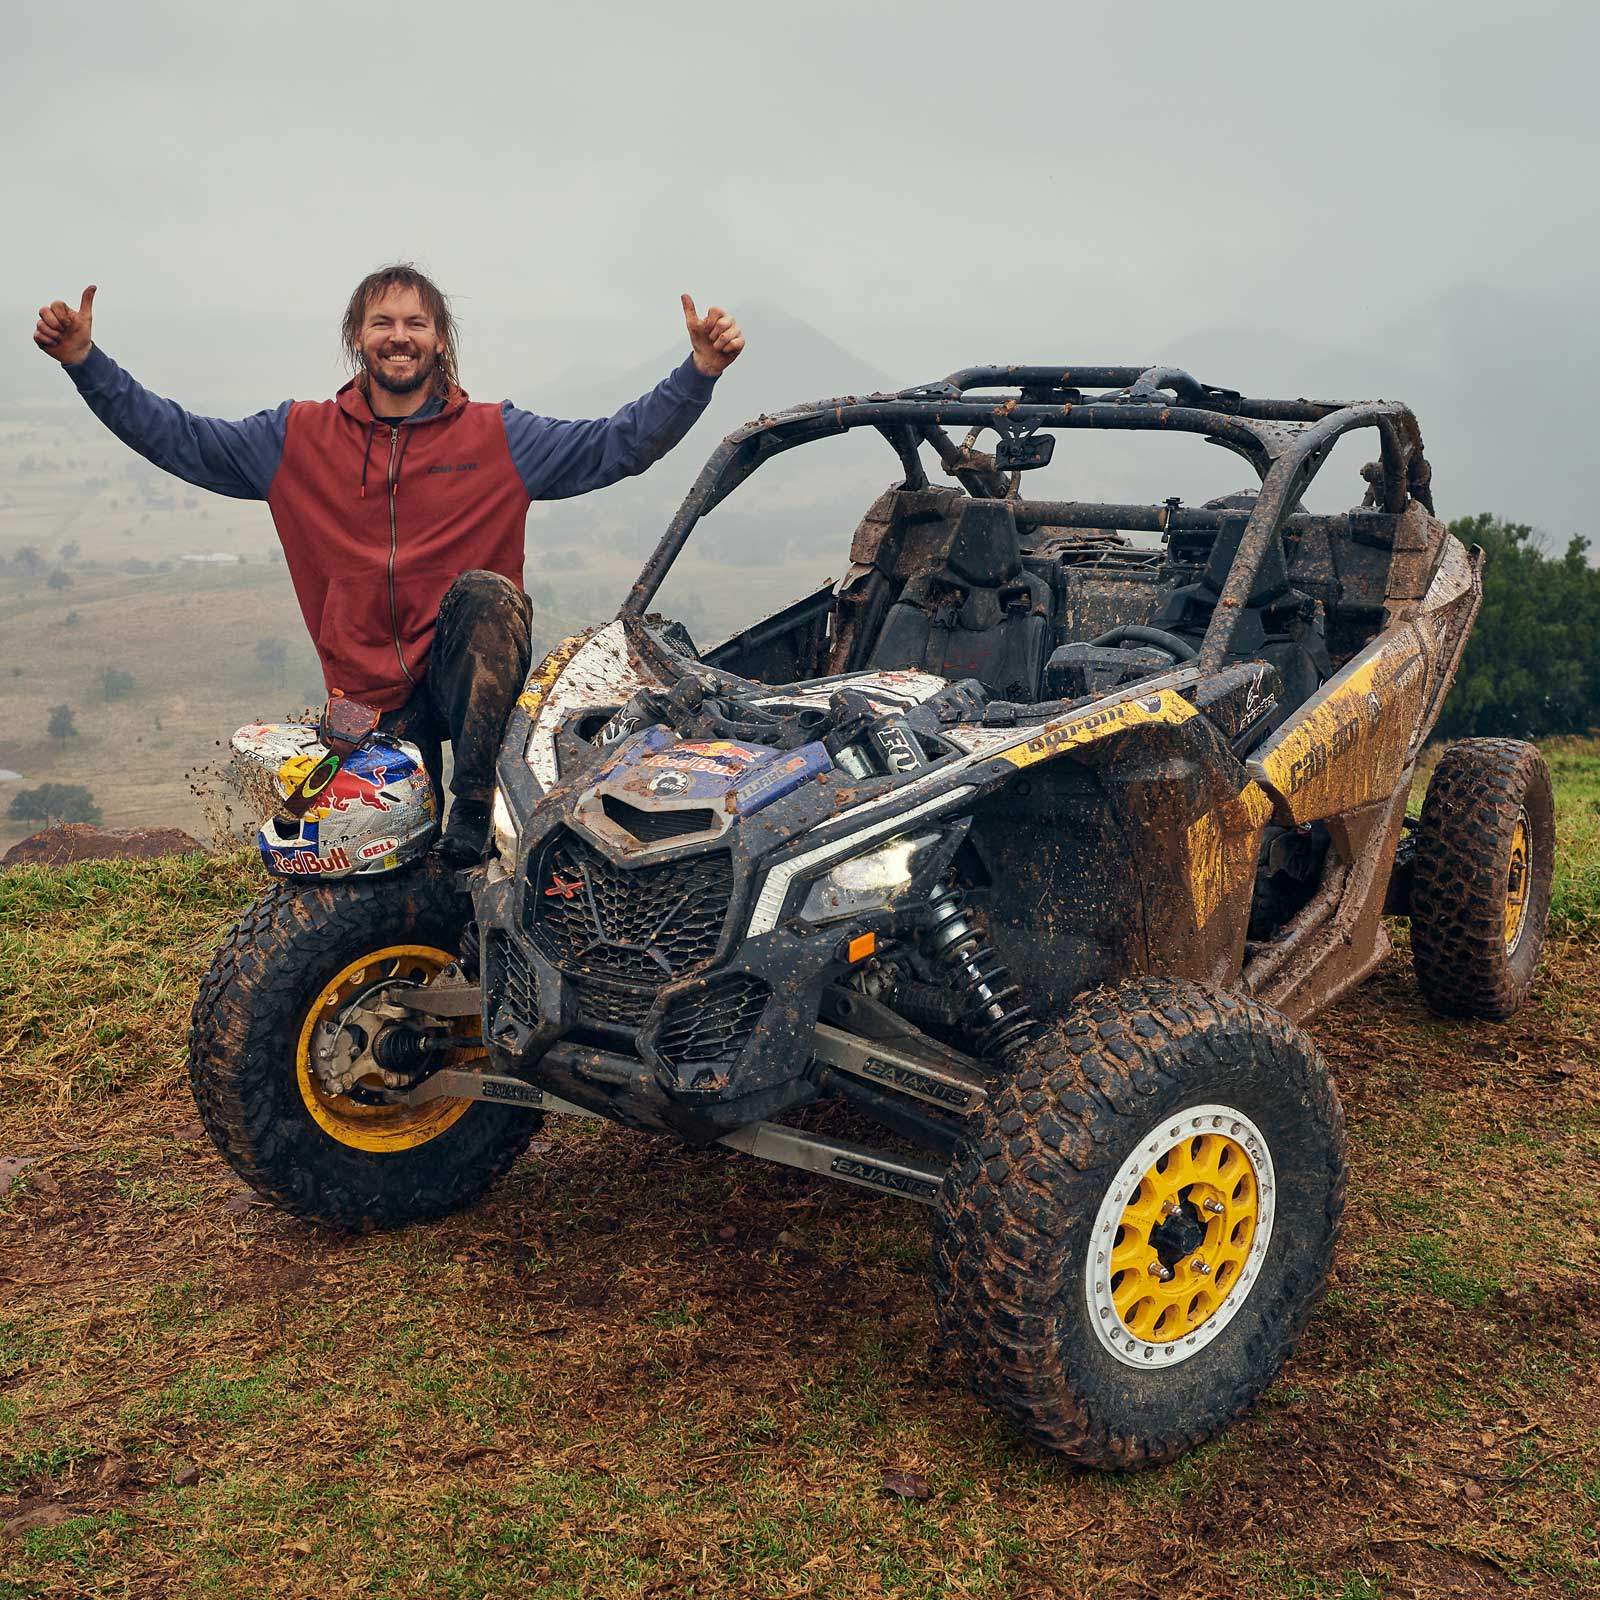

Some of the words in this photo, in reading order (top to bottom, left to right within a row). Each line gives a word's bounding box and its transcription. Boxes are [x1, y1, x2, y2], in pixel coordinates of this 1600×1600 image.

[270, 849, 303, 875] Red
[303, 846, 352, 875] Bull
[363, 840, 396, 858] BELL
